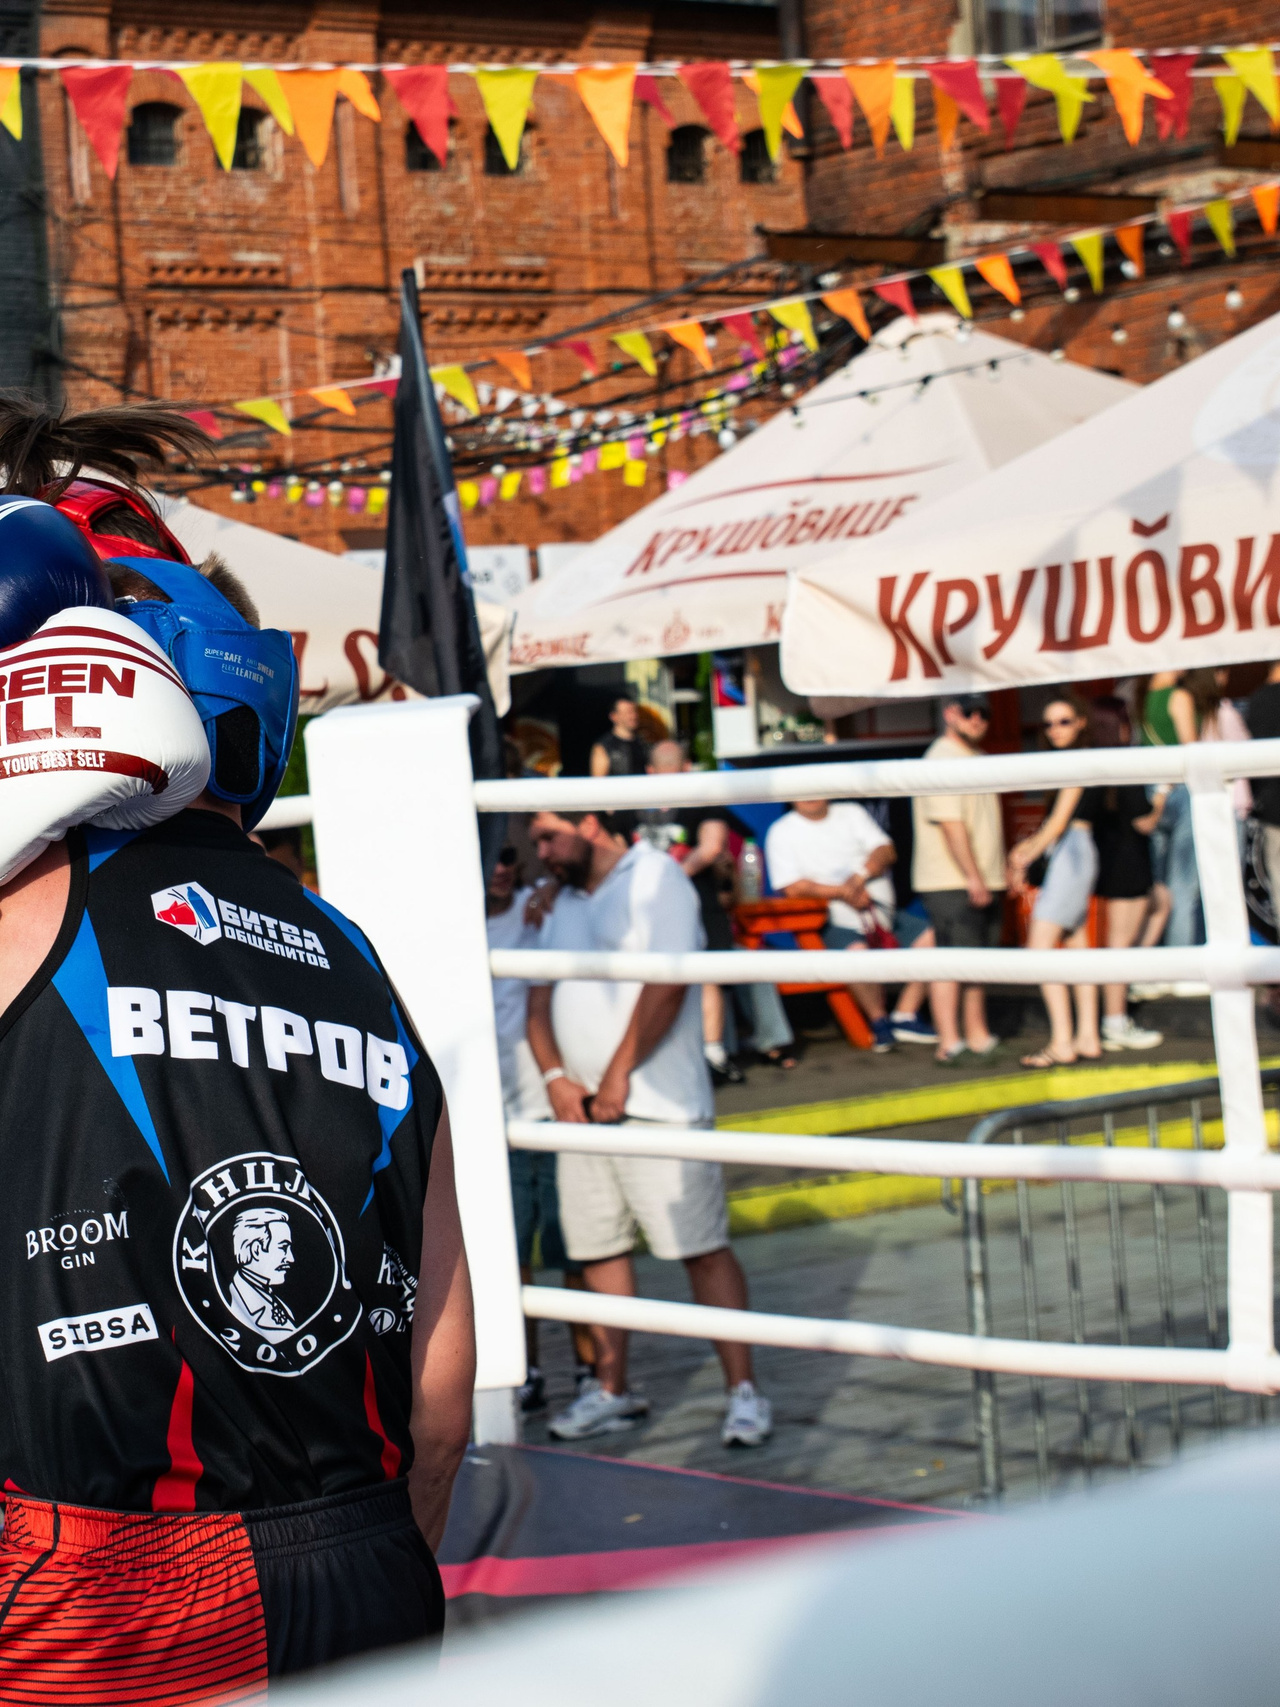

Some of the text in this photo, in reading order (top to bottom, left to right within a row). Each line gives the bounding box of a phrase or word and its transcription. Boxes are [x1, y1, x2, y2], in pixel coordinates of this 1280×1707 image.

[204, 647, 242, 664] SUPER SAFE
[257, 662, 274, 679] SWEAT
[221, 663, 264, 684] FLEX LEATHER
[3, 756, 38, 776] YOUR
[41, 752, 73, 769] BEST
[77, 751, 106, 768] SELF
[217, 898, 326, 955] БИТВА
[223, 925, 330, 970] ОБЩЕПИТОВ
[107, 987, 410, 1111] ВЕТРОВ
[26, 1211, 130, 1260] BROOM
[61, 1252, 95, 1269] GIN
[48, 1312, 150, 1350] SIBSA
